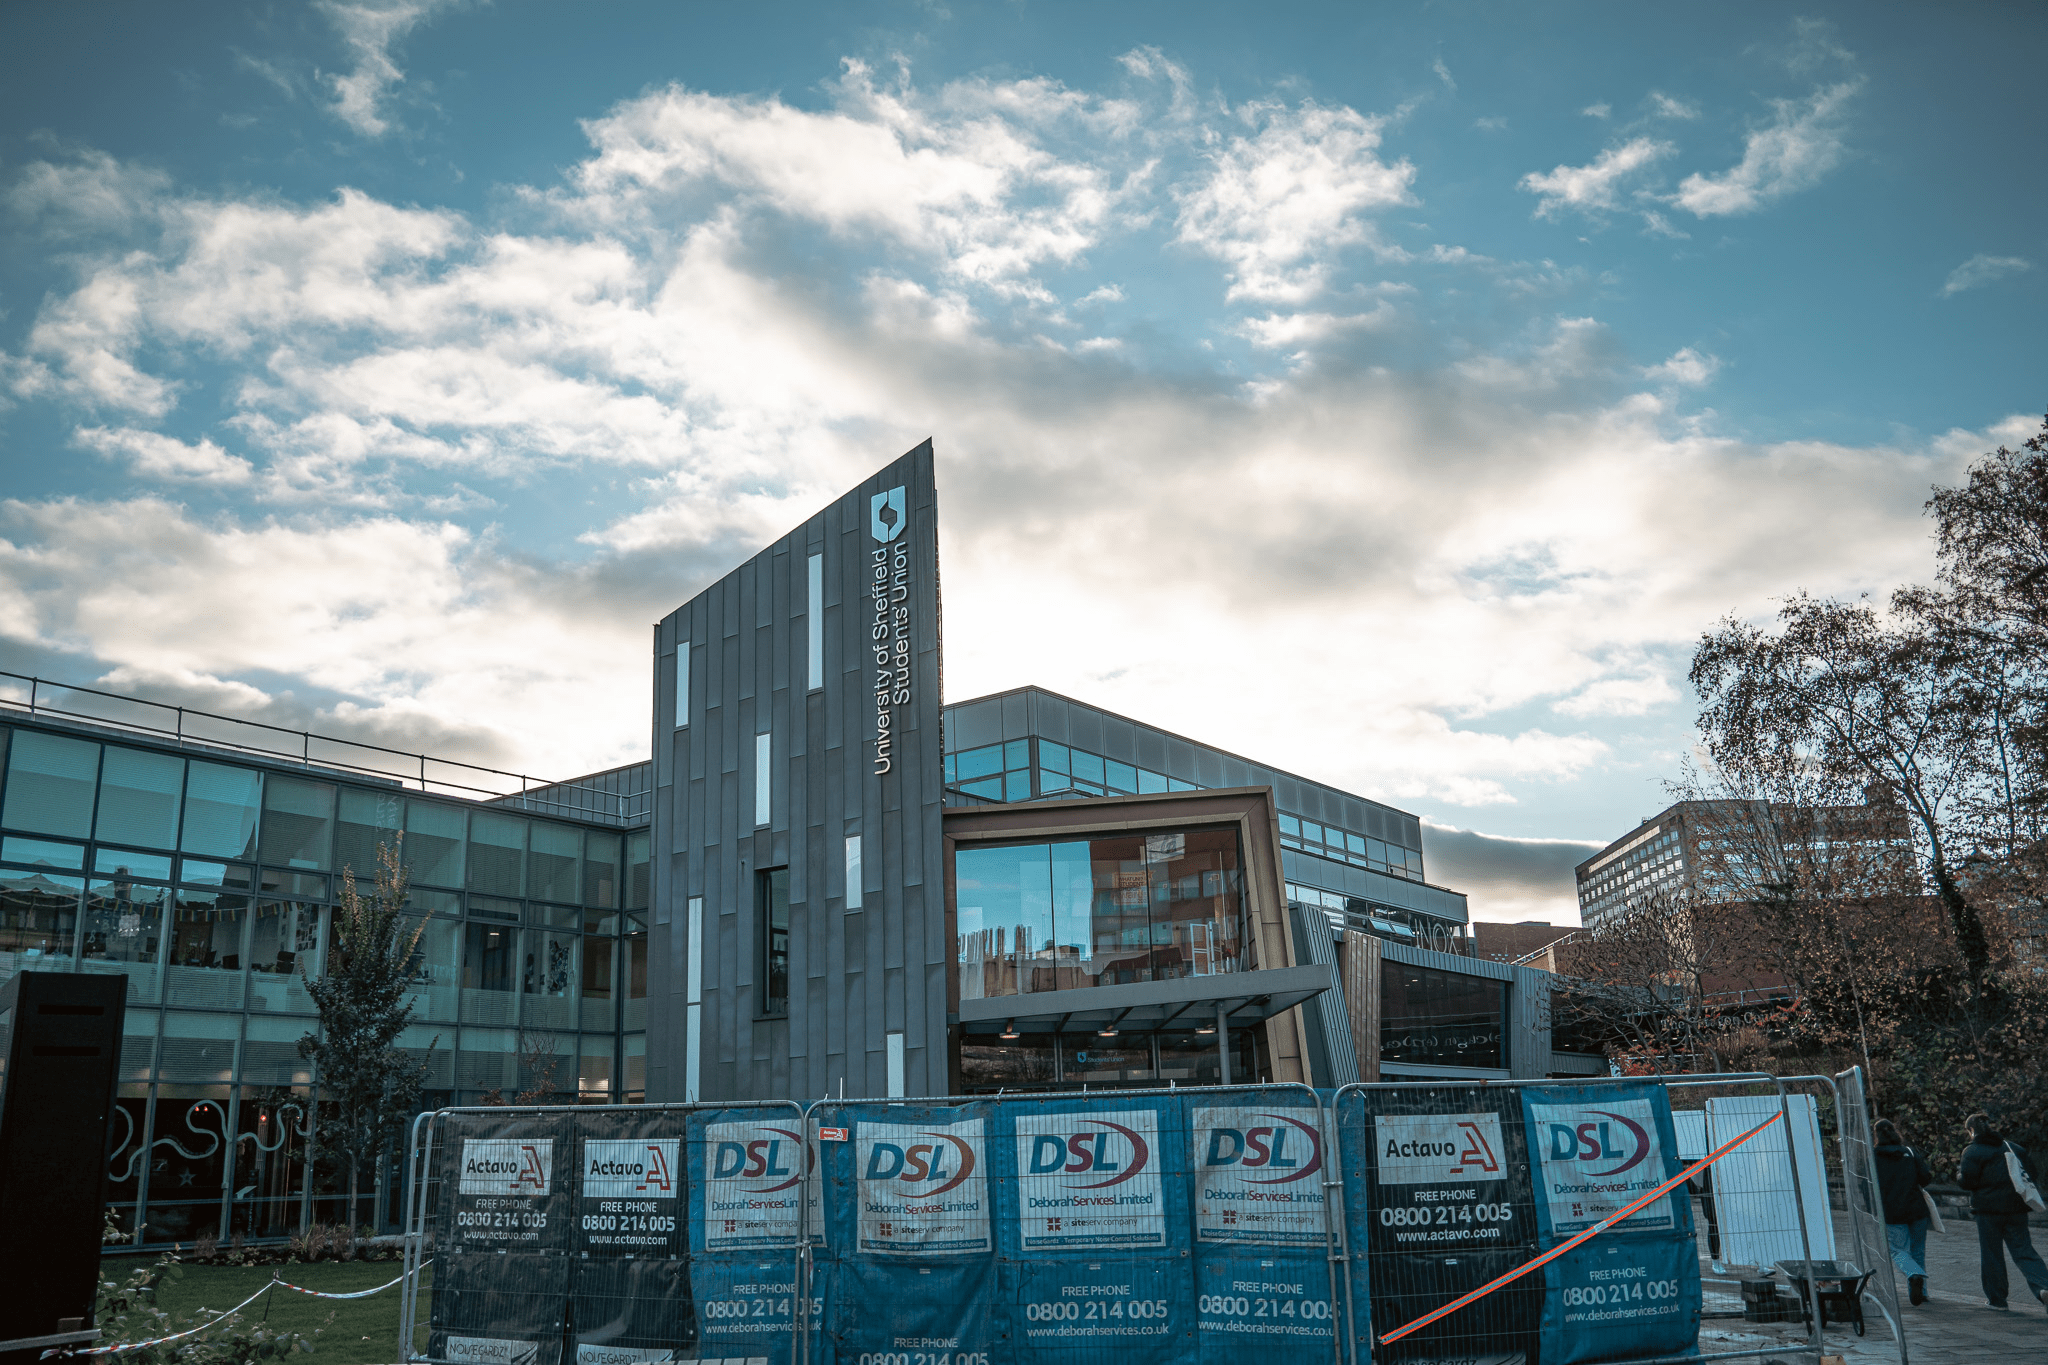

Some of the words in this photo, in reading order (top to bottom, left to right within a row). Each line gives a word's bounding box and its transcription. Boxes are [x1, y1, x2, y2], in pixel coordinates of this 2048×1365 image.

[891, 541, 907, 602] Union
[871, 547, 888, 640] Sheffield
[873, 644, 889, 665] of
[874, 669, 892, 774] University
[1206, 1127, 1296, 1167] DSL
[1386, 1139, 1456, 1157] Actavo
[1550, 1122, 1624, 1160] DSL
[713, 1140, 789, 1179] DSL
[1030, 1133, 1118, 1174] DSL
[466, 1158, 517, 1174] Actavo
[590, 1160, 643, 1175] Actavo
[866, 1142, 947, 1182] DSL
[1030, 1193, 1153, 1208] DeborahServicesLimited
[1205, 1189, 1324, 1203] DeborahServicesLimite
[1414, 1191, 1439, 1202] FREE
[1440, 1189, 1477, 1200] PHONE
[476, 1199, 499, 1209] FREE
[500, 1199, 532, 1210] PHONE
[600, 1202, 623, 1212] FREE
[626, 1202, 657, 1213] PHONE
[866, 1200, 979, 1215] DeborahServicesLimited
[458, 1212, 491, 1227] 0800
[494, 1212, 519, 1228] 214
[523, 1212, 547, 1228] 005
[1278, 1215, 1315, 1225] company
[1380, 1206, 1432, 1227] 0800
[1436, 1205, 1472, 1225] 214
[1476, 1203, 1513, 1222] 005
[582, 1215, 617, 1231] 0800
[620, 1216, 647, 1231] 214
[650, 1216, 676, 1232] 005
[775, 1220, 797, 1229] compa
[932, 1225, 965, 1233] company
[464, 1230, 539, 1241] www.actavo.com
[589, 1234, 667, 1246] www.actavo.com
[1238, 1232, 1267, 1240] Temporary
[1396, 1228, 1500, 1242] www.actavo.com
[1589, 1270, 1611, 1282] FREE
[1611, 1267, 1648, 1279] PHONE
[733, 1284, 757, 1294] FREE
[760, 1284, 796, 1294] PHONE
[1062, 1286, 1089, 1297] FREE
[1091, 1285, 1130, 1296] PHONE
[1233, 1281, 1260, 1293] FREE
[1262, 1283, 1304, 1295] PHONE
[1562, 1286, 1607, 1307] 0800
[1609, 1282, 1644, 1304] 214
[1647, 1279, 1679, 1300] 005
[705, 1300, 748, 1318] 0800
[752, 1298, 790, 1317] 214
[1026, 1302, 1080, 1322] 0800
[1084, 1301, 1124, 1320] 214
[1128, 1300, 1168, 1319] 005
[1199, 1294, 1250, 1316] 0800
[1254, 1298, 1296, 1318] 214
[1565, 1301, 1680, 1323] www.deborahservices.co.uk
[1027, 1323, 1169, 1337] www.deborahservices.co.uk
[1198, 1320, 1335, 1337] www.deborahservices.co.u
[894, 1338, 920, 1348] FREE
[921, 1338, 959, 1348] PHONE
[860, 1353, 909, 1365] 0800
[915, 1353, 950, 1365] 214
[956, 1352, 990, 1365] 005
